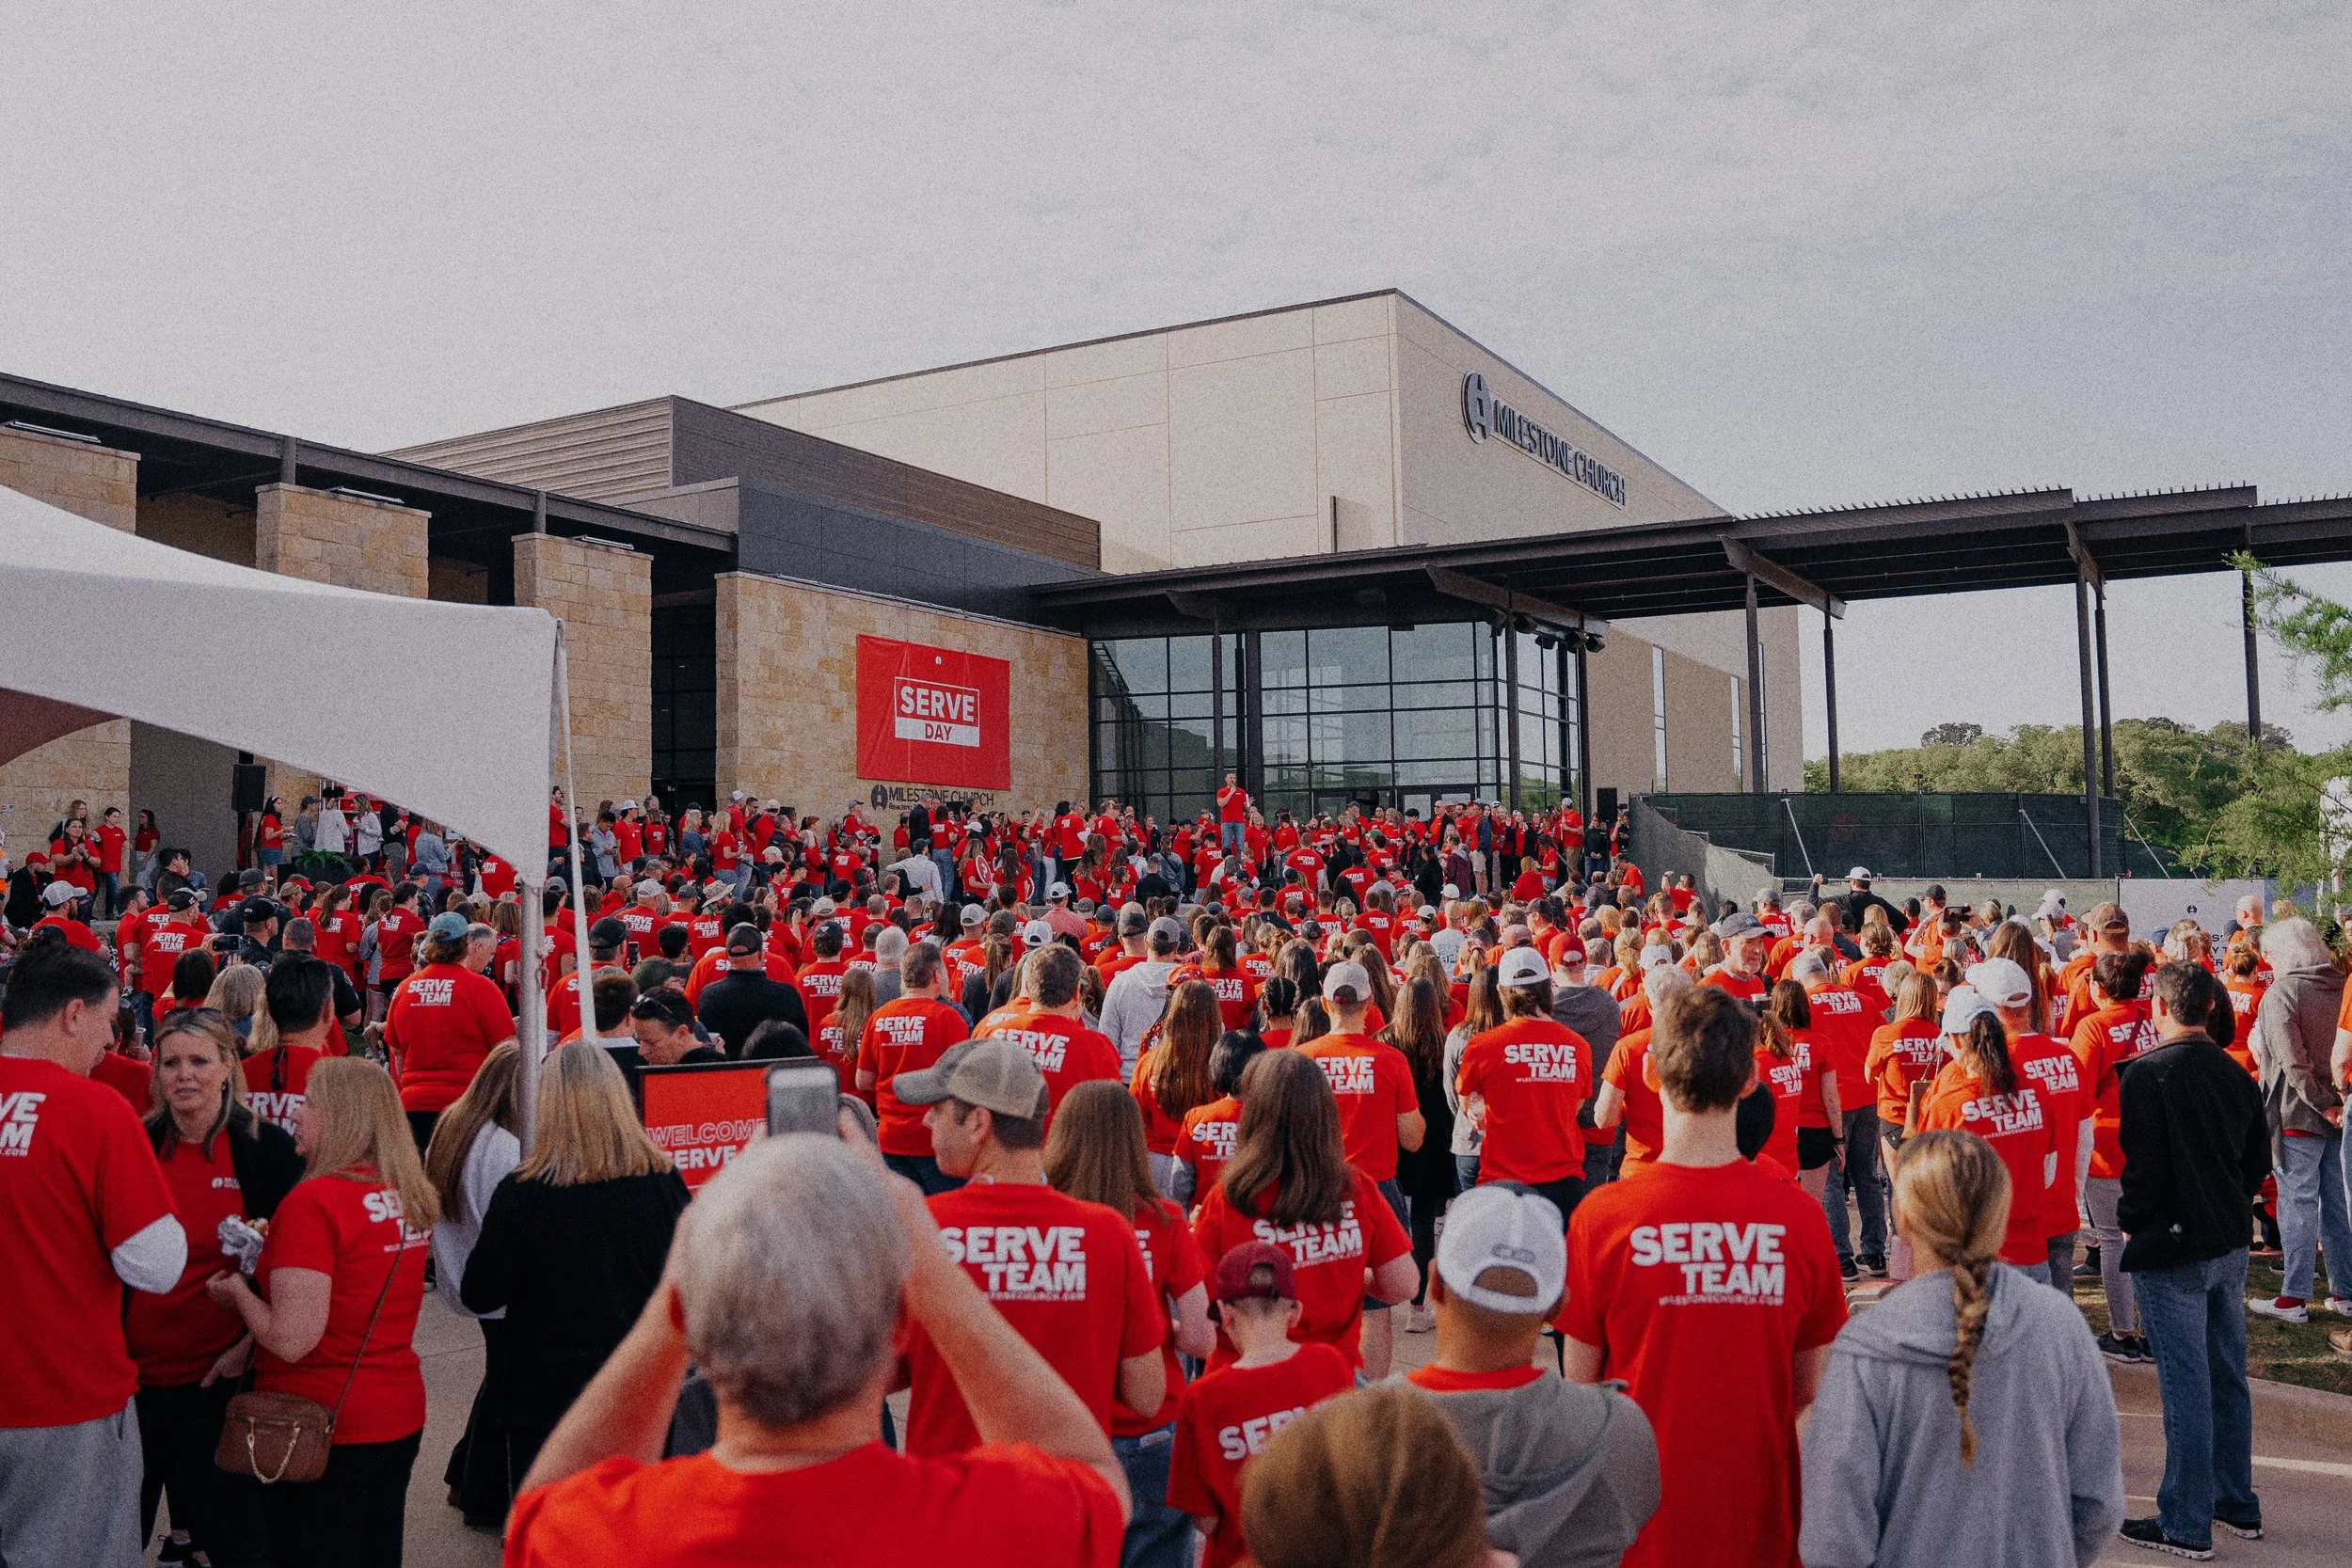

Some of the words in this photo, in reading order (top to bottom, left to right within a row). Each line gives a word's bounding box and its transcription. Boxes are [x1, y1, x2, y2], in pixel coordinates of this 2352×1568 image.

[1493, 400, 1574, 475] MILESTONE
[1574, 451, 1626, 506] CHURCH
[900, 685, 975, 722] SERVE
[925, 722, 953, 742] DAY
[148, 913, 169, 923] SER
[623, 914, 654, 925] SERVE
[694, 921, 719, 931] SERVE
[630, 922, 652, 932] TEAM
[702, 927, 719, 937] TEAM
[152, 932, 187, 942] SERVE
[160, 942, 183, 951] TEAM
[1863, 966, 1883, 976] SER
[407, 979, 455, 993] SERVE
[1215, 978, 1243, 990] RVE
[419, 992, 453, 1004] TEAM
[1810, 991, 1859, 1005] SERVE
[1829, 999, 1861, 1012] TEAM
[875, 1017, 926, 1032] SERVE
[820, 1027, 844, 1040] SER
[890, 1030, 924, 1043] TEAM
[830, 1038, 843, 1051] TE
[1032, 1050, 1065, 1070] AM
[1504, 1043, 1577, 1064] SERVE
[1315, 1055, 1375, 1075] ERVE
[1528, 1062, 1577, 1079] TEAM
[2023, 1054, 2075, 1079] SERVE
[2042, 1072, 2079, 1091] TEAM
[1961, 1088, 2041, 1122] SERVE
[1990, 1106, 2043, 1133] TEAM
[1192, 1121, 1238, 1142] SER
[1214, 1140, 1237, 1157] TE
[940, 1226, 1086, 1264] SERVE
[1290, 1227, 1363, 1263] TEAM
[1629, 1221, 1787, 1267] SERVE
[981, 1261, 1087, 1292] TEAM
[1680, 1261, 1786, 1296] TEAM
